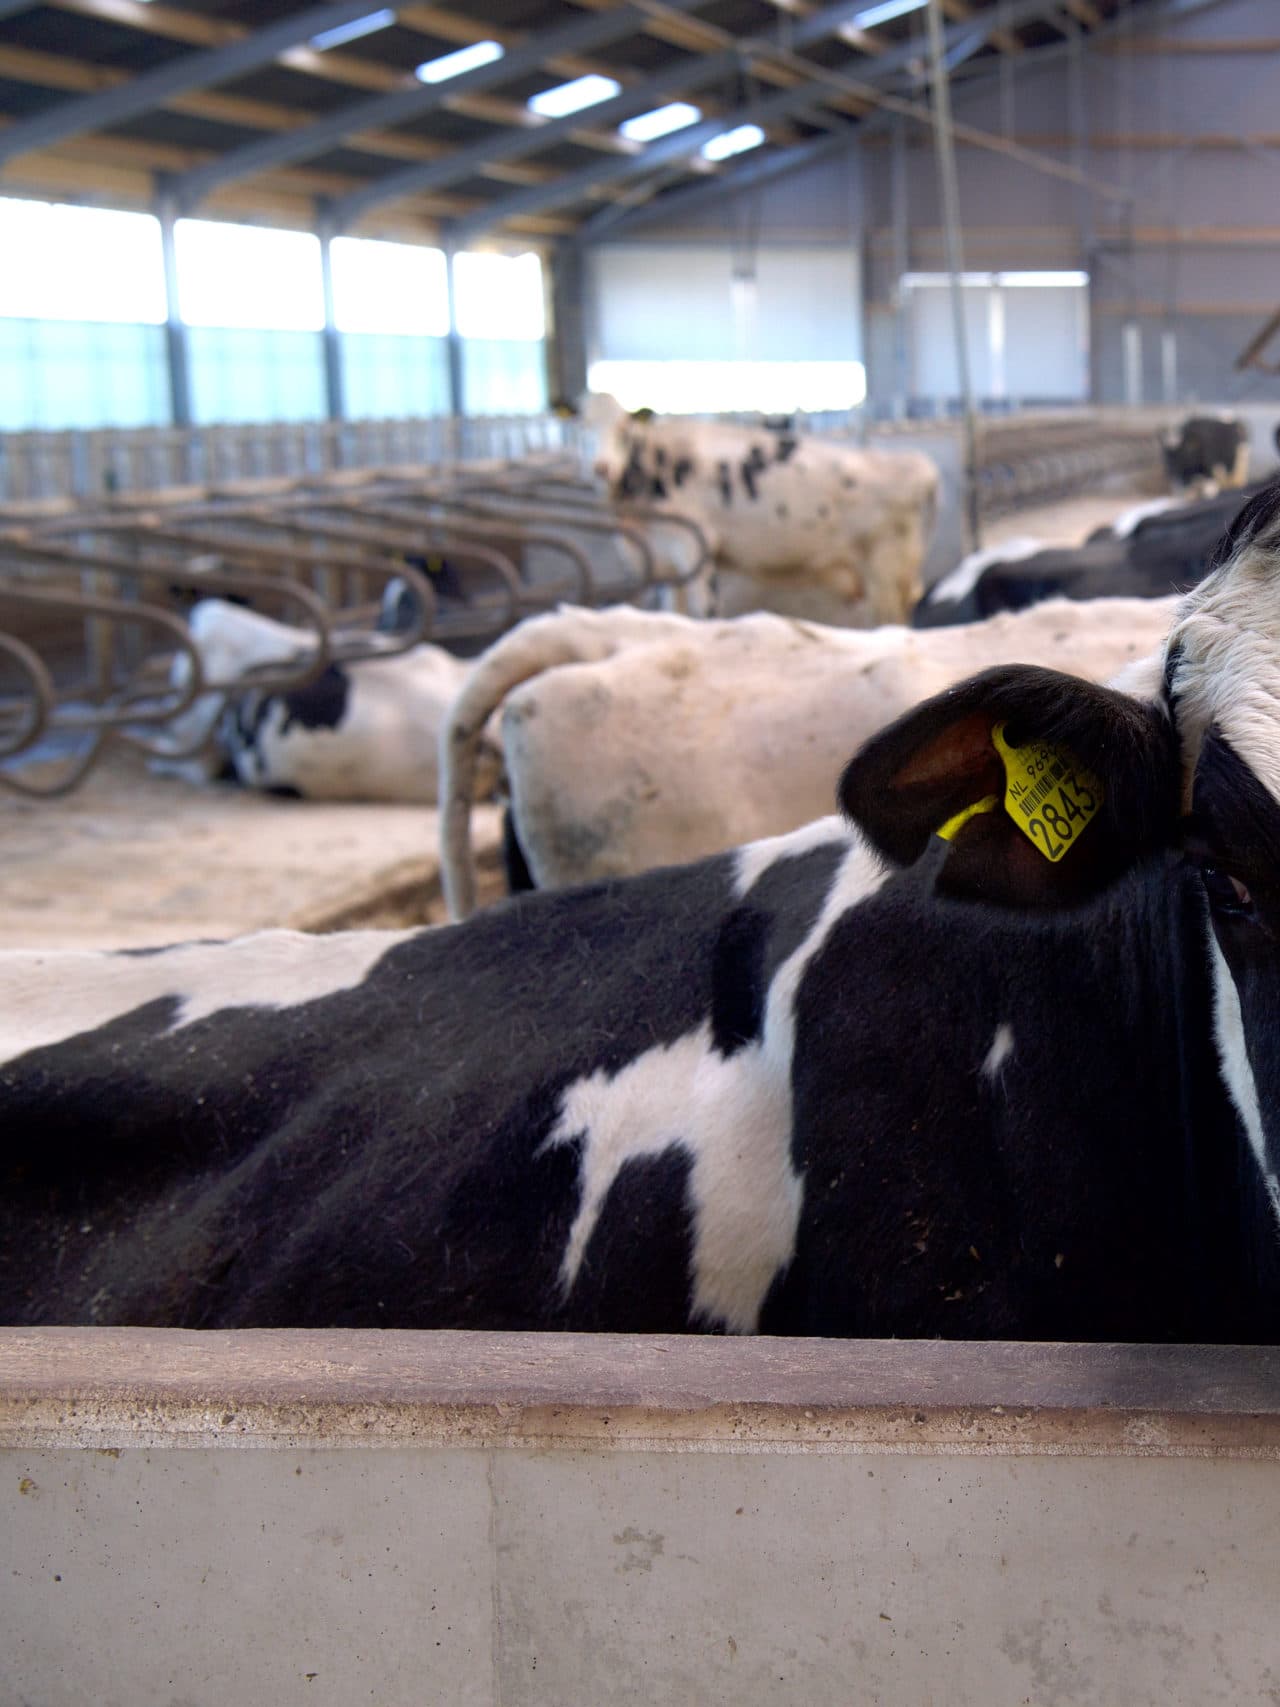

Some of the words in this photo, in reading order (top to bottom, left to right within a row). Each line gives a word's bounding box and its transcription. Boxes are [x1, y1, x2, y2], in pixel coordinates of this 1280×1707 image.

[1008, 780, 1029, 801] NL
[1026, 749, 1049, 779] 969
[1028, 774, 1097, 859] 2843
